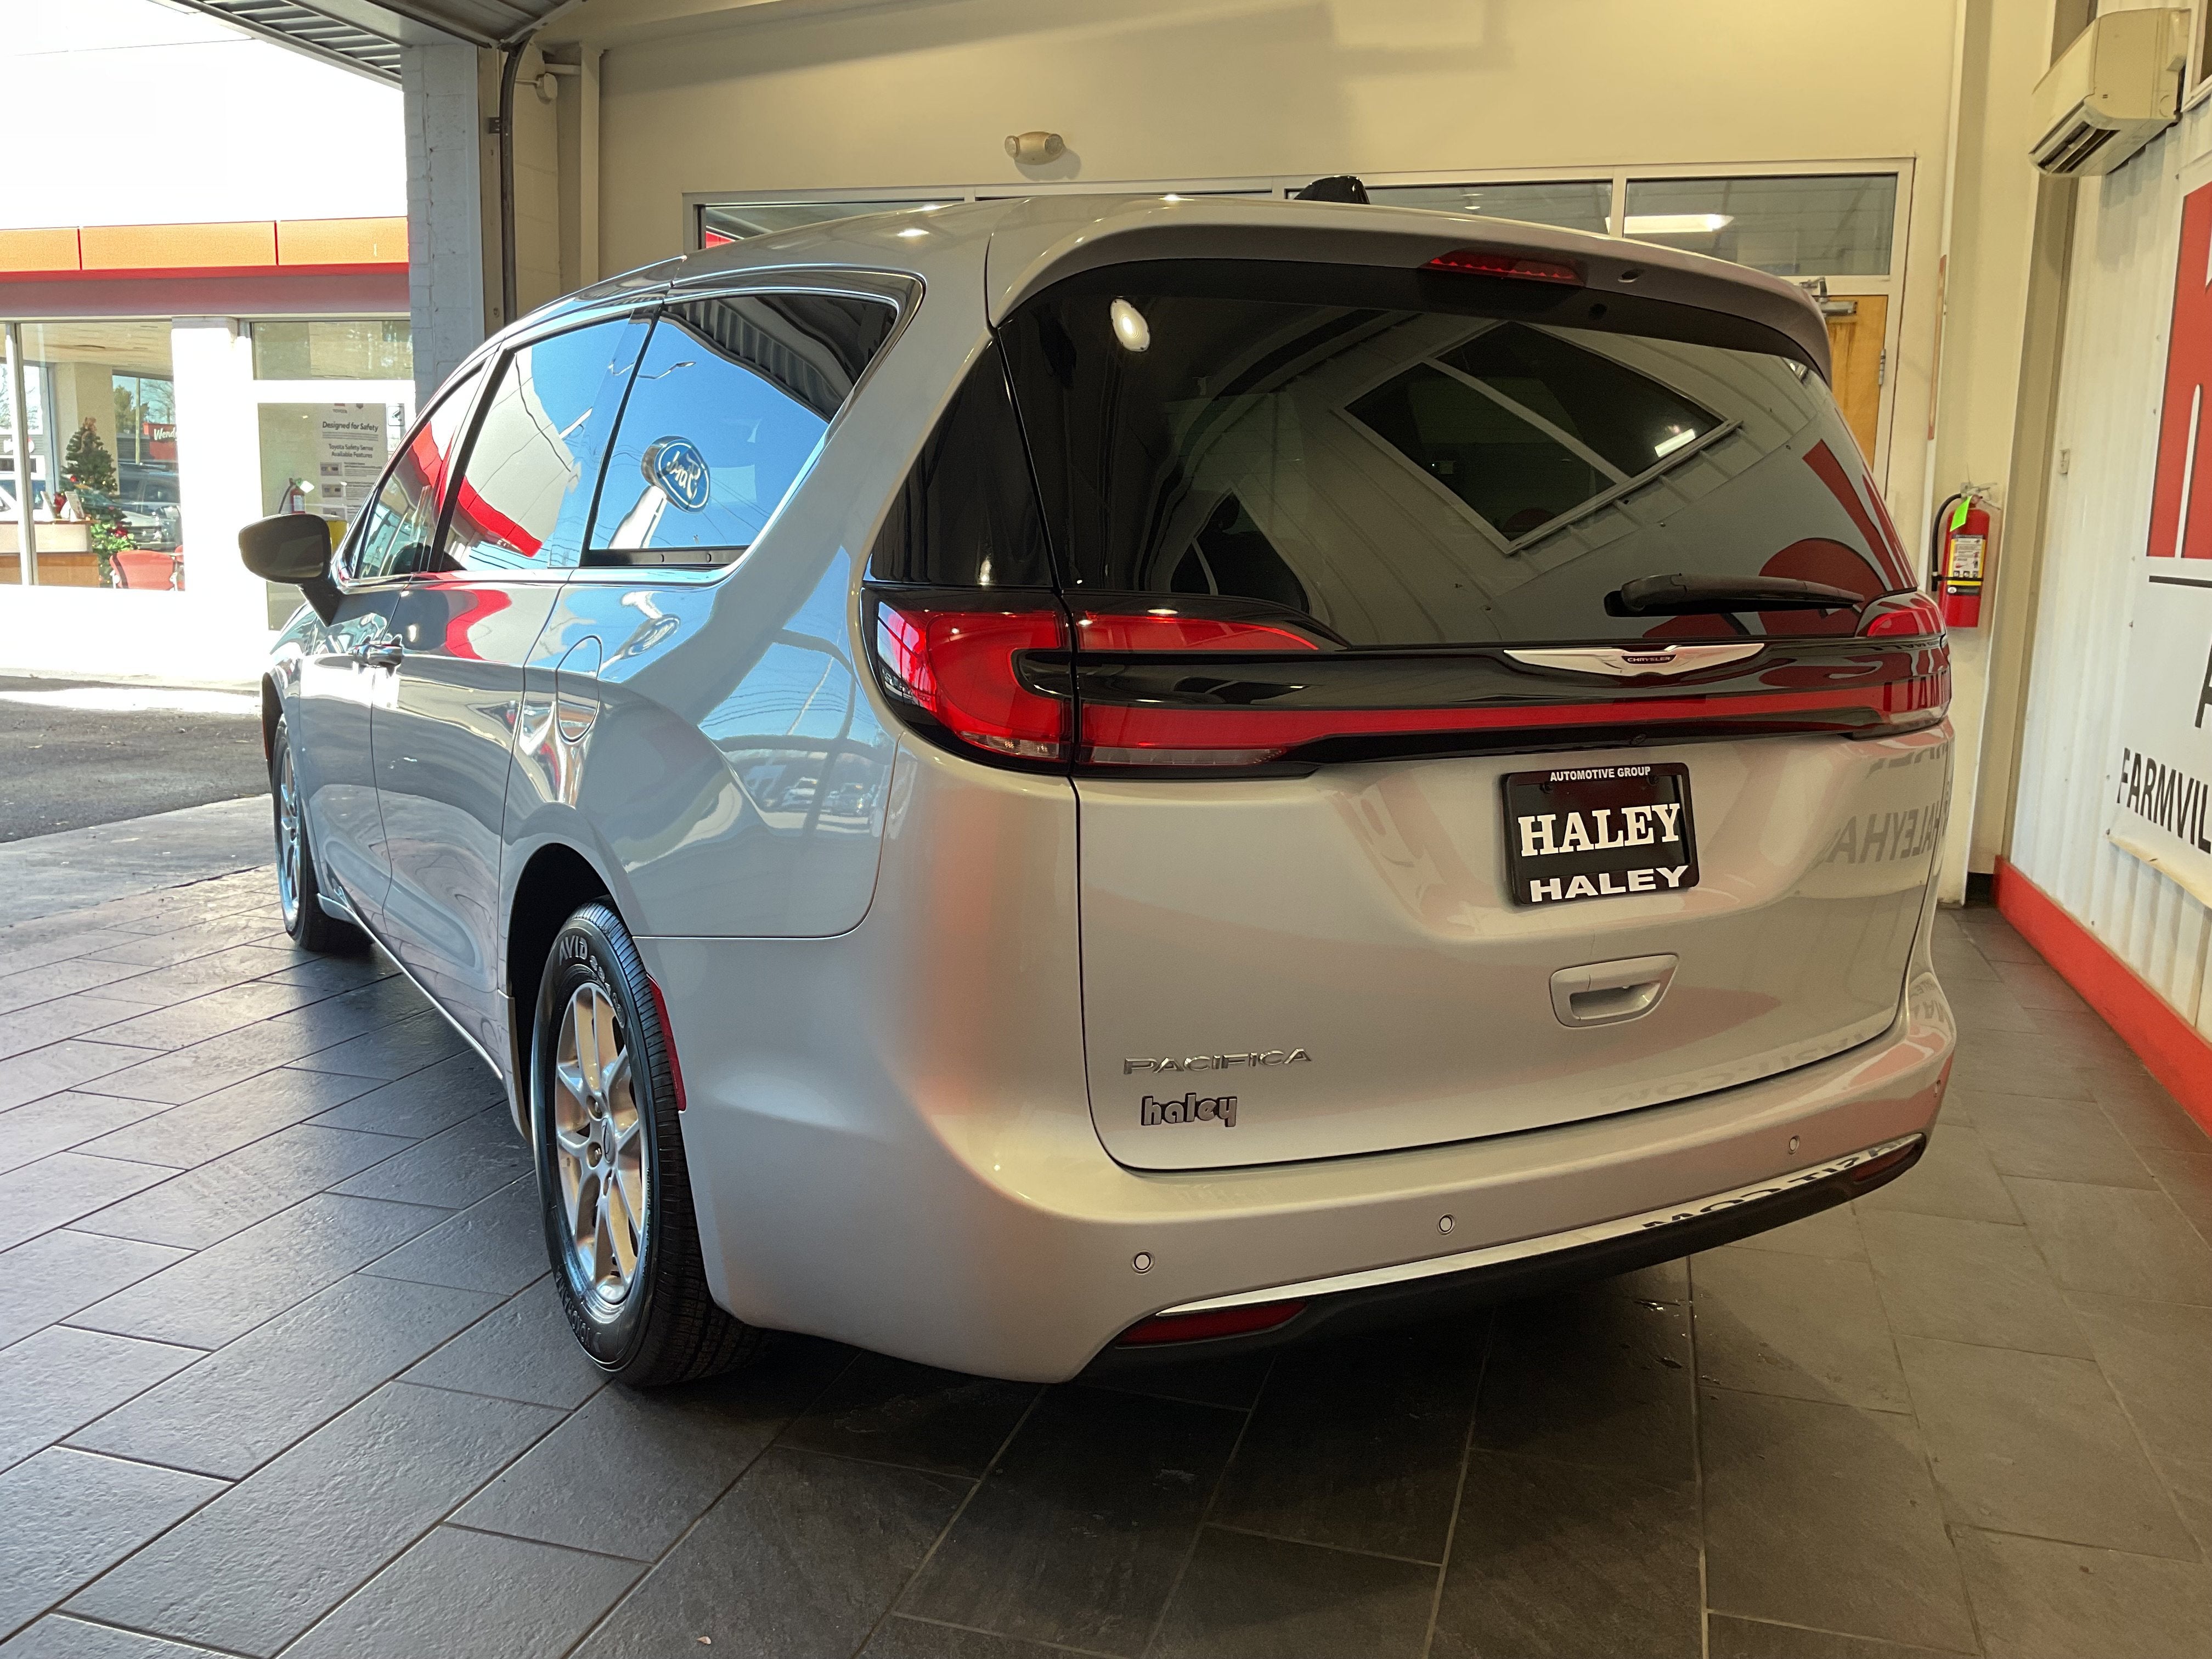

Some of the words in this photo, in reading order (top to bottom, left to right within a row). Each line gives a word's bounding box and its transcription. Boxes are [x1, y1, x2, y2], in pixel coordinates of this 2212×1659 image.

[322, 421, 350, 430] Designed
[360, 423, 379, 432] Safety
[1550, 768, 1615, 782] AUTOMOTIVE
[1617, 766, 1651, 777] GROUP
[2117, 747, 2211, 855] FARMVIL
[1517, 803, 1680, 857] HALEY
[1530, 865, 1689, 902] HALEY
[558, 935, 588, 966] AVID
[1123, 1048, 1312, 1075] PACIFICA
[1141, 1092, 1238, 1127] haley
